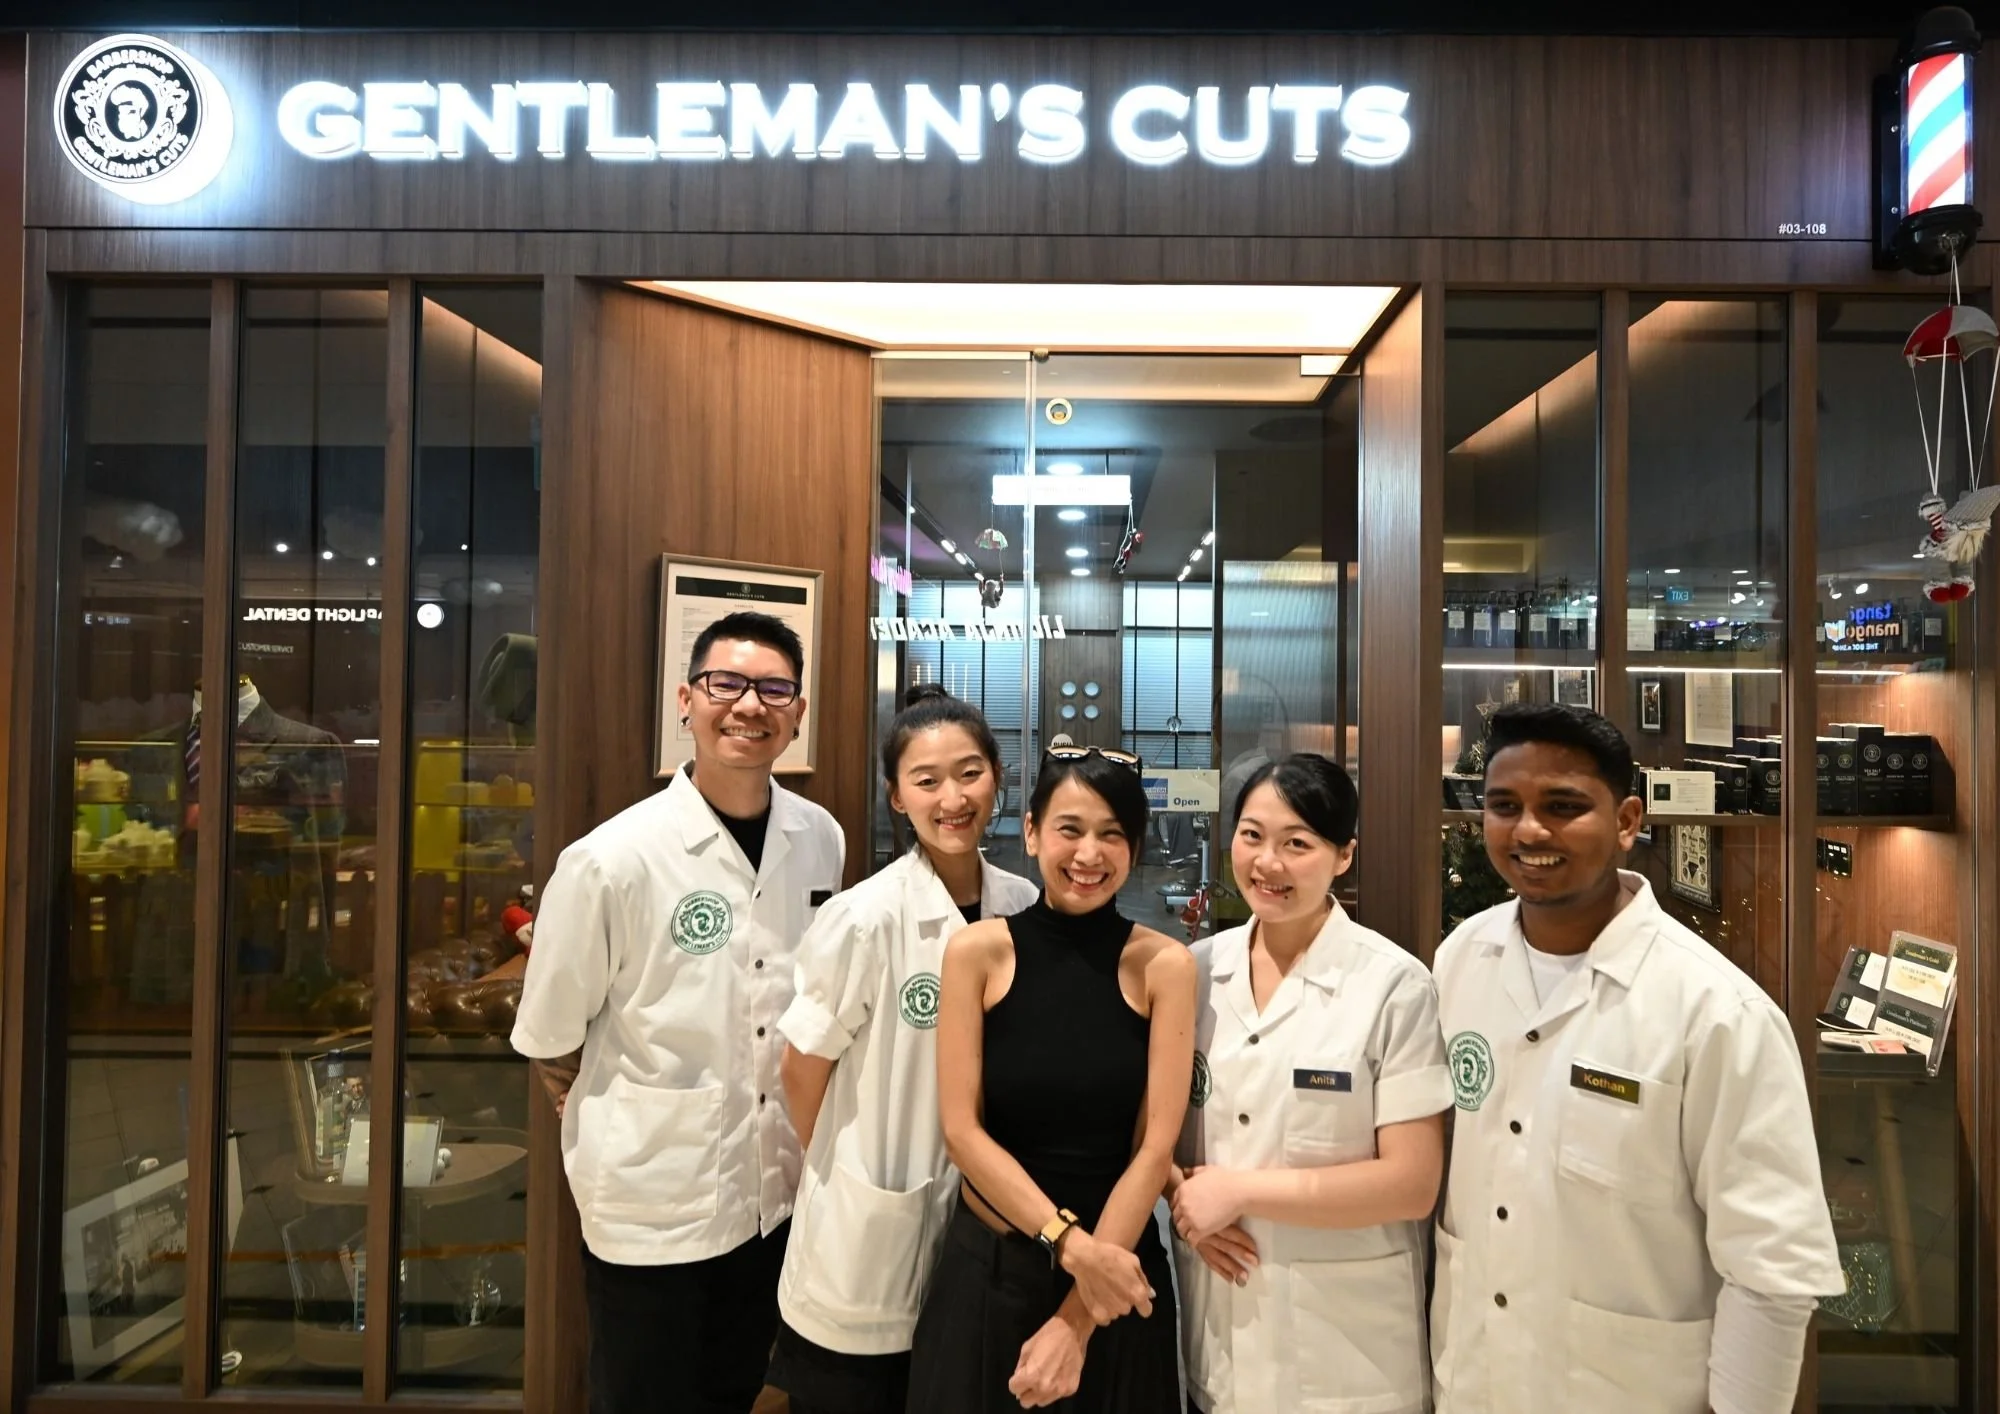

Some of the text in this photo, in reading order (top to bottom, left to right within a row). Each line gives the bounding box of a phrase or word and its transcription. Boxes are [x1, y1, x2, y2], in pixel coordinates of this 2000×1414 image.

[86, 49, 174, 78] BARBERSHOP
[277, 80, 1412, 166] GENTLEMAN'S CUTS
[73, 133, 189, 178] GENTLEMAN'S CUTS
[1778, 223, 1827, 235] #03-108
[1173, 797, 1200, 807] Open
[1310, 1074, 1336, 1086] Anita
[1583, 1072, 1625, 1093] Kothan
